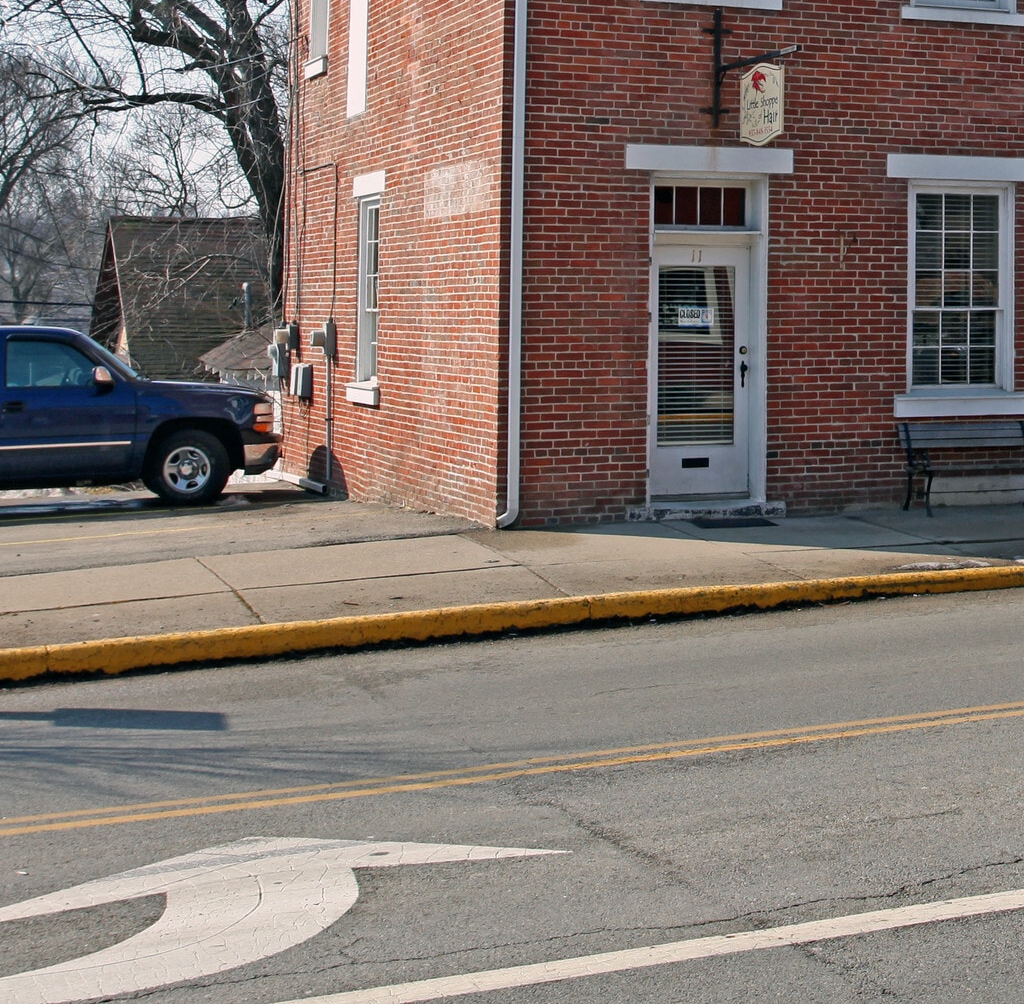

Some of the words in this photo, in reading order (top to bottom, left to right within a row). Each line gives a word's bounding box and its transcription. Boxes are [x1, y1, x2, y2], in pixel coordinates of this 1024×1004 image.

[760, 95, 778, 108] Shoppe
[763, 108, 778, 124] Hair
[691, 249, 702, 263] 11
[679, 308, 701, 319] CLOSED
